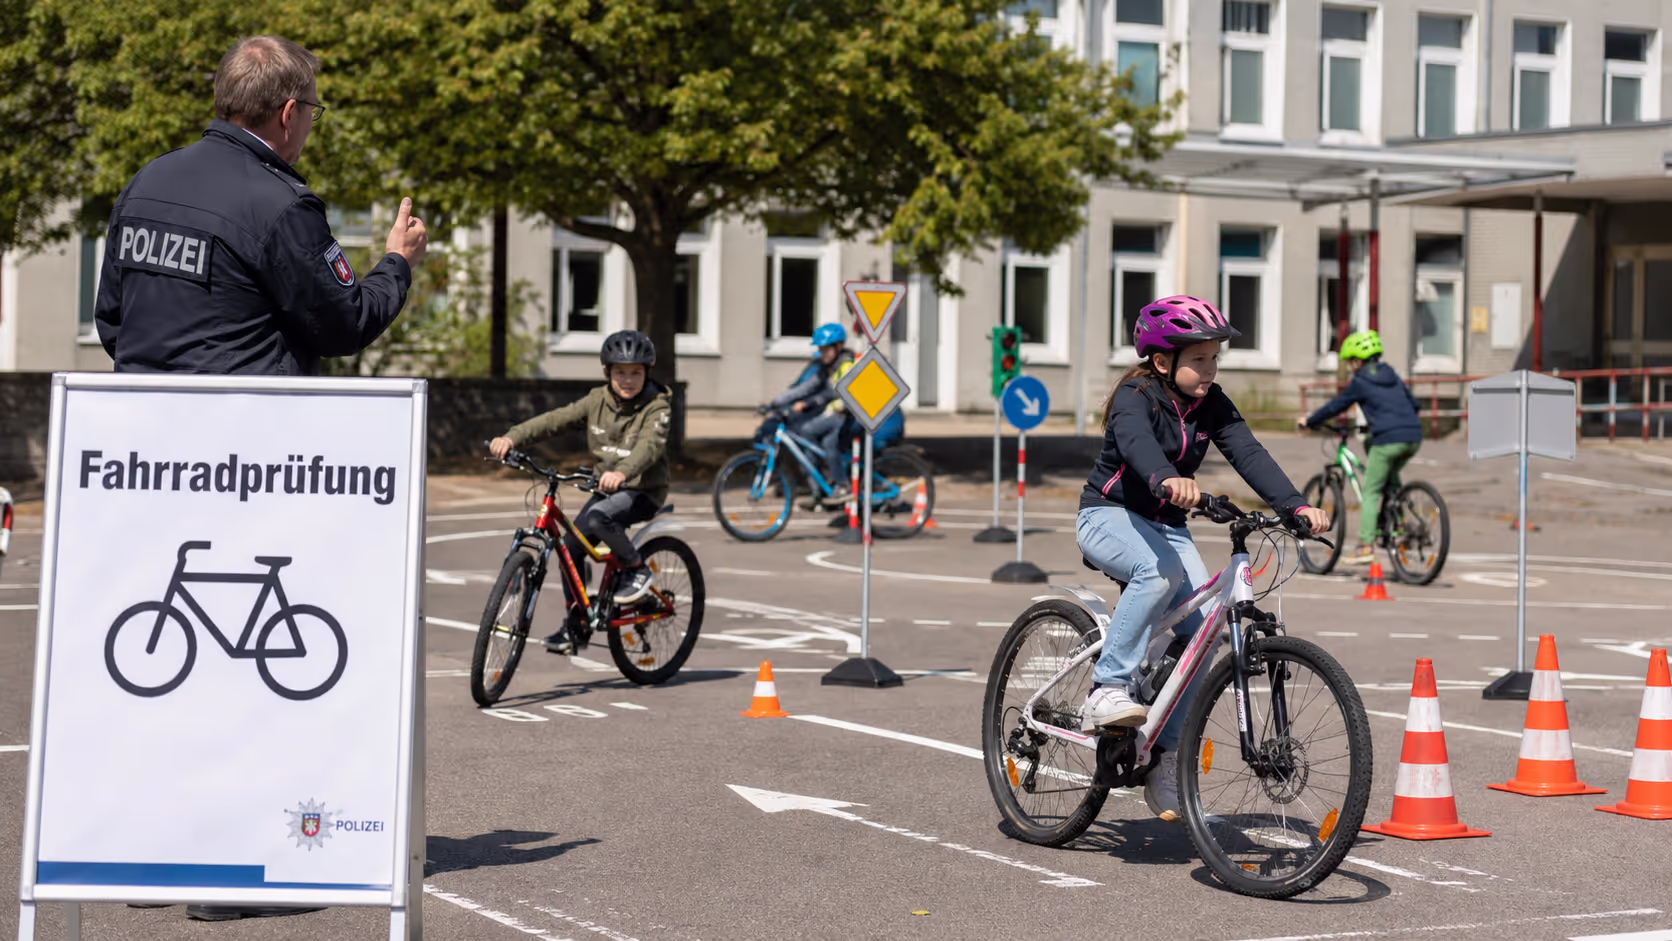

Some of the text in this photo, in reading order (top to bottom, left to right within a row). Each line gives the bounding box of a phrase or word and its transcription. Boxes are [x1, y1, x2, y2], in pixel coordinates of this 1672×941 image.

[119, 226, 207, 275] POLIZEI
[80, 449, 396, 505] Fahrradprüfung
[336, 820, 384, 832] POLIZEI
